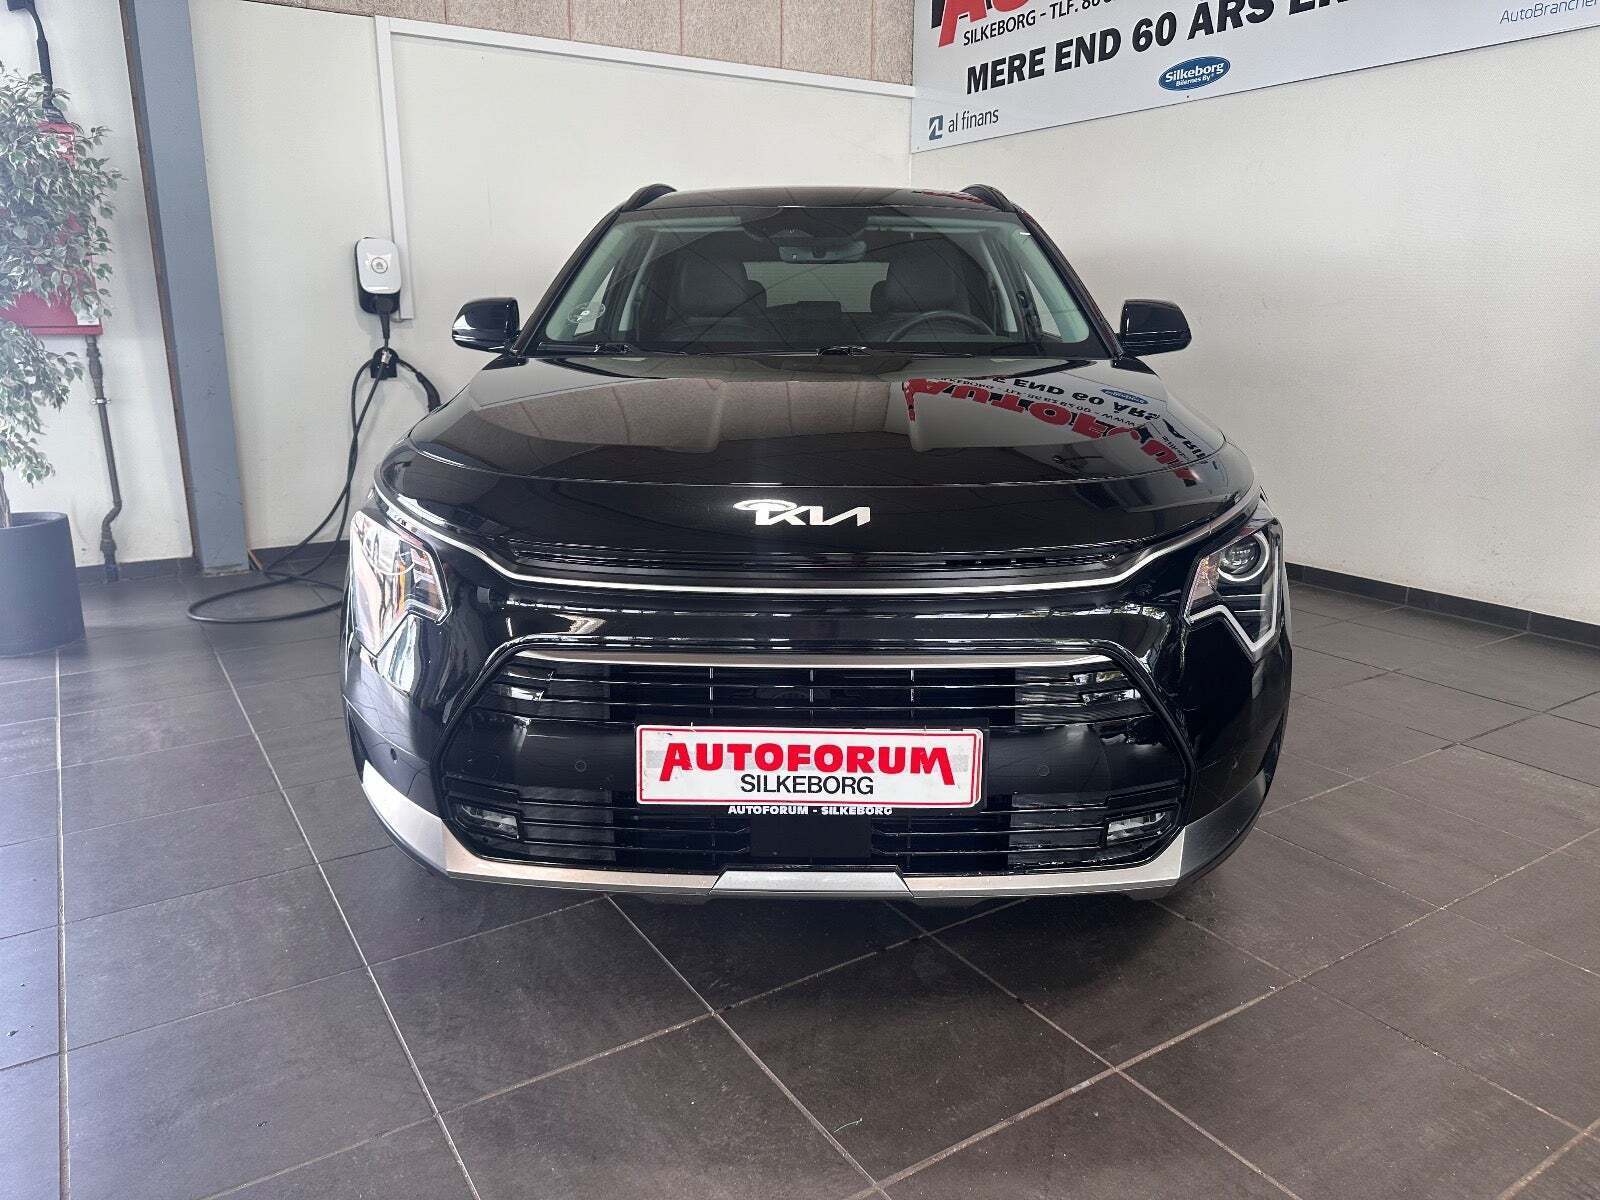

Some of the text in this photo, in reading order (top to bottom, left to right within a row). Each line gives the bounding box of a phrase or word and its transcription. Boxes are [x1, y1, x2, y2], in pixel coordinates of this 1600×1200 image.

[963, 9, 1036, 46] SILKEBORG
[1049, 0, 1078, 19] TLF.
[967, 46, 1046, 95] MERE
[1055, 27, 1122, 73] END
[1132, 11, 1177, 53] 60
[1165, 62, 1225, 83] Silkeborg
[948, 108, 999, 133] al finans
[755, 500, 871, 527] KIA
[659, 742, 956, 786] AUTOFORUM
[740, 773, 875, 795] SILKEBORG
[727, 805, 809, 815] AUTOFORUM
[821, 805, 893, 816] SILKEBORG
